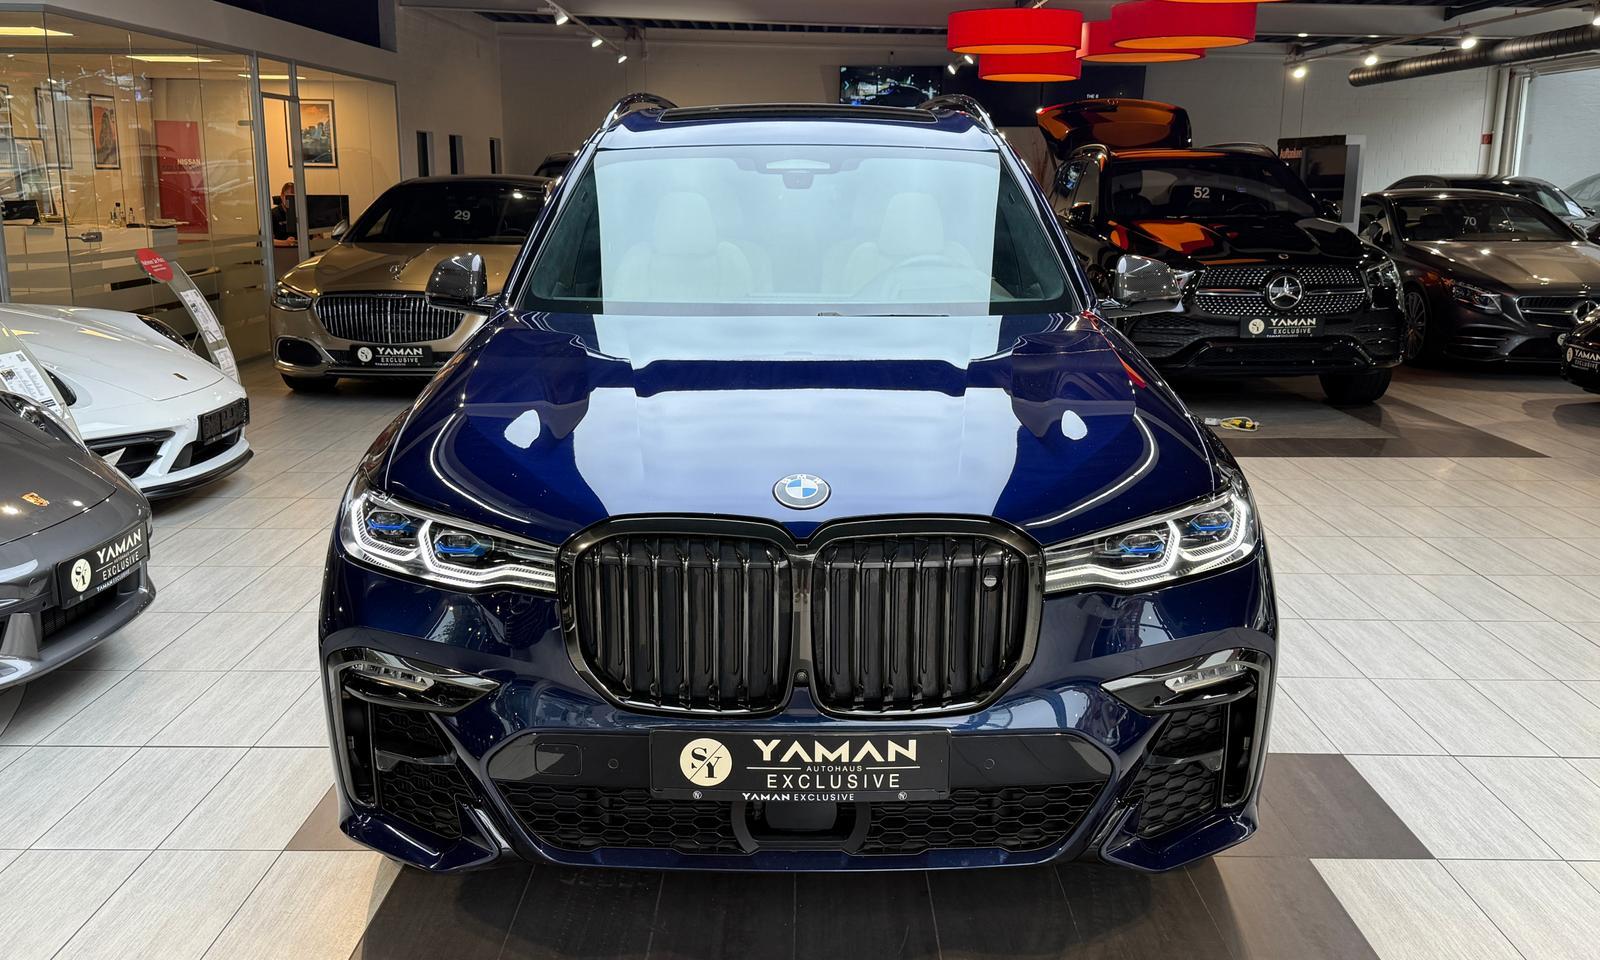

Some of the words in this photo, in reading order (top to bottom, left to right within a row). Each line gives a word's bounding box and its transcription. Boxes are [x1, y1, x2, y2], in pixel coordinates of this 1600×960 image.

[177, 158, 201, 166] NISSAN
[1193, 186, 1210, 199] 52
[454, 209, 471, 221] 29
[1463, 215, 1477, 226] 70
[1270, 317, 1317, 327] YAMAN
[376, 347, 423, 355] YAMAN
[96, 528, 142, 565] YAMAN
[102, 551, 140, 581] EXCLUSIVE
[752, 738, 917, 763] YAMAN
[806, 765, 863, 773] AUTOHAUS
[766, 773, 900, 789] EXCLUSIVE
[742, 792, 791, 801] YAMAN
[793, 793, 855, 802] EXCLUSIVE
